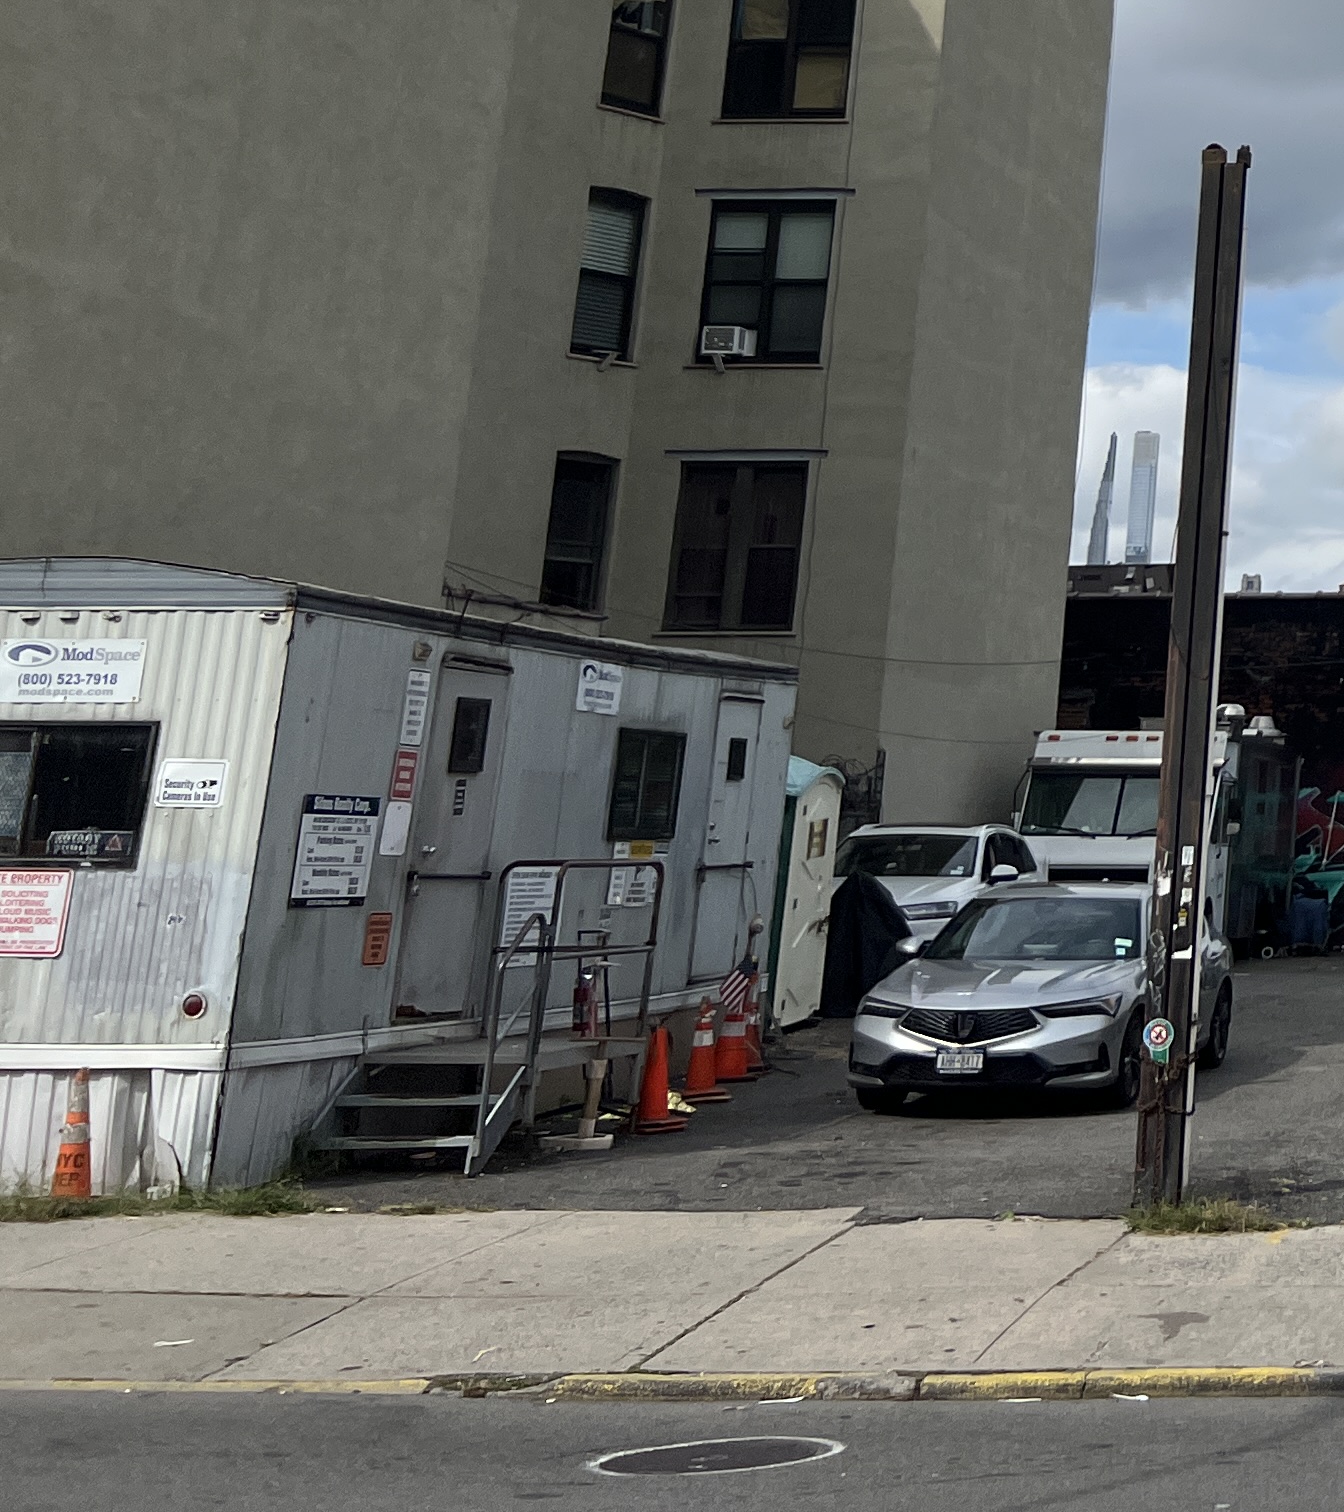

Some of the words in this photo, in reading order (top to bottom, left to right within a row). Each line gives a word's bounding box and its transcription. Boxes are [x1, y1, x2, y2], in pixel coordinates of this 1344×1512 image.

[61, 647, 140, 665] ModSpace
[18, 673, 53, 688] (800)
[57, 673, 119, 685] 523-7918
[18, 687, 115, 699] modspace.com
[11, 873, 64, 884] PROPERTY
[0, 926, 34, 934] UMPING
